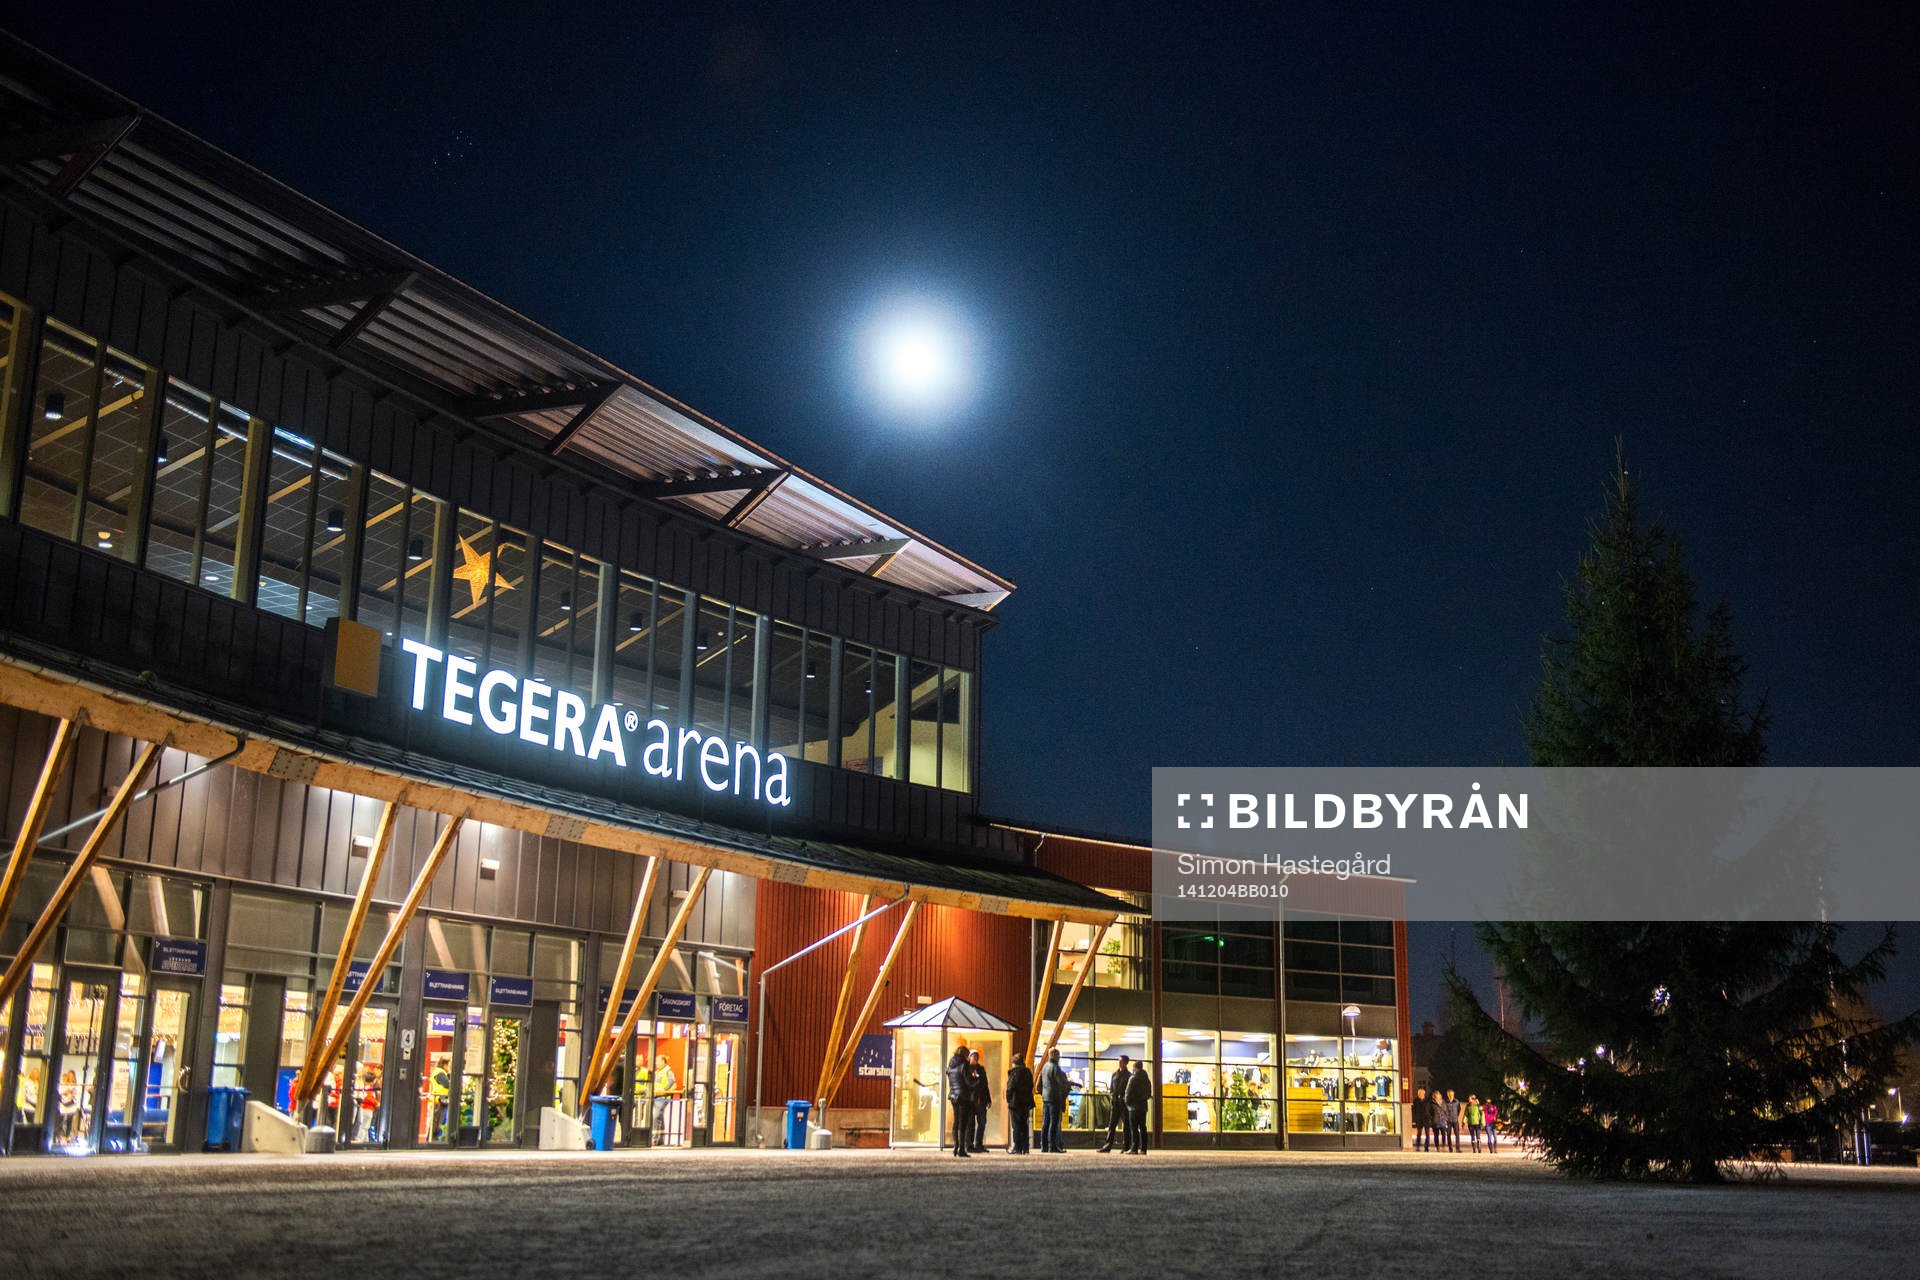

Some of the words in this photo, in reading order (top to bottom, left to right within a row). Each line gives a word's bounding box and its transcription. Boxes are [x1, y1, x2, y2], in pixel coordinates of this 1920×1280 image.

[641, 717, 792, 808] arena
[718, 1001, 744, 1014] FÖRETAG
[857, 1064, 892, 1077] starsho
